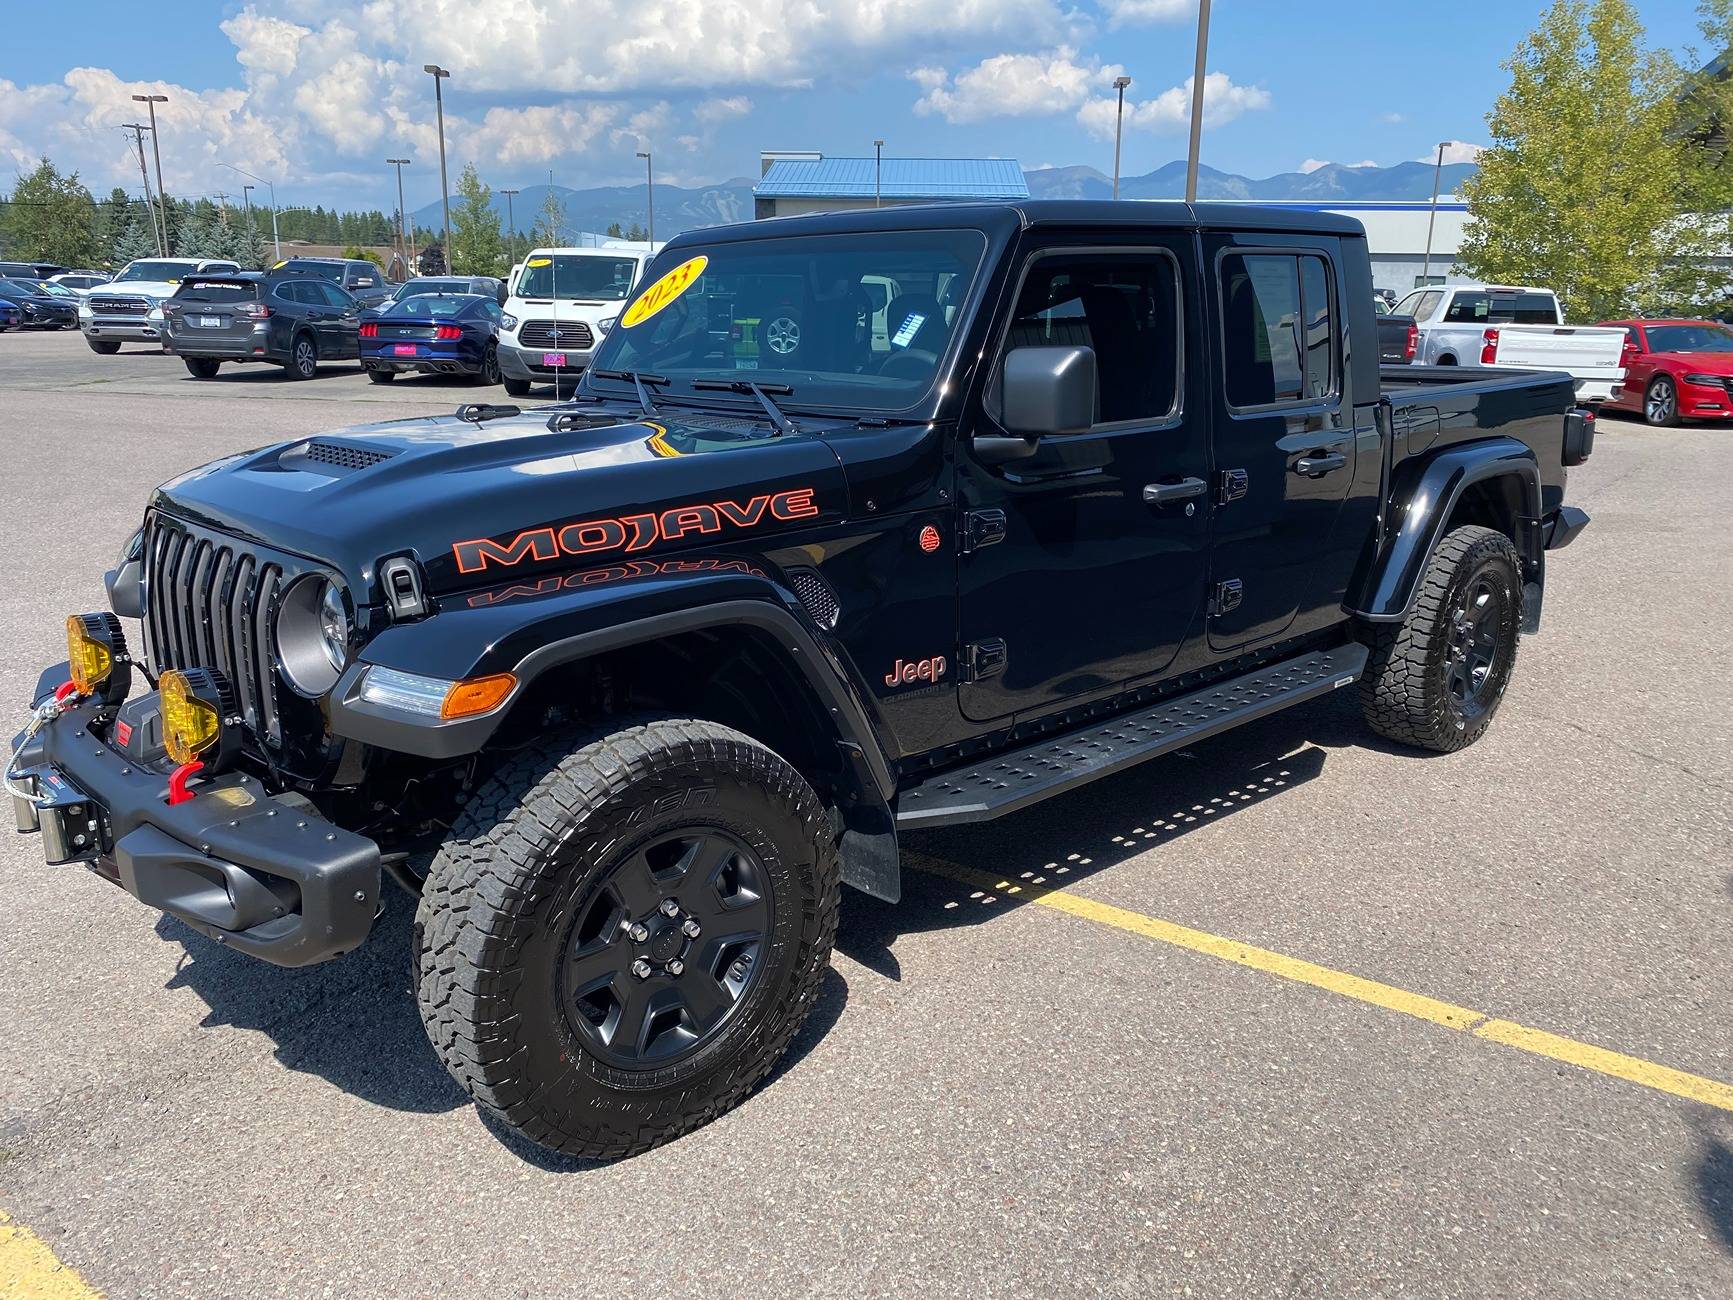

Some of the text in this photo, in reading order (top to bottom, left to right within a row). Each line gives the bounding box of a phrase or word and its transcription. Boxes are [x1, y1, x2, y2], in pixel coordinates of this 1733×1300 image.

[633, 264, 692, 321] 2023
[452, 488, 818, 574] MOJAVE
[885, 656, 947, 687] Jeep
